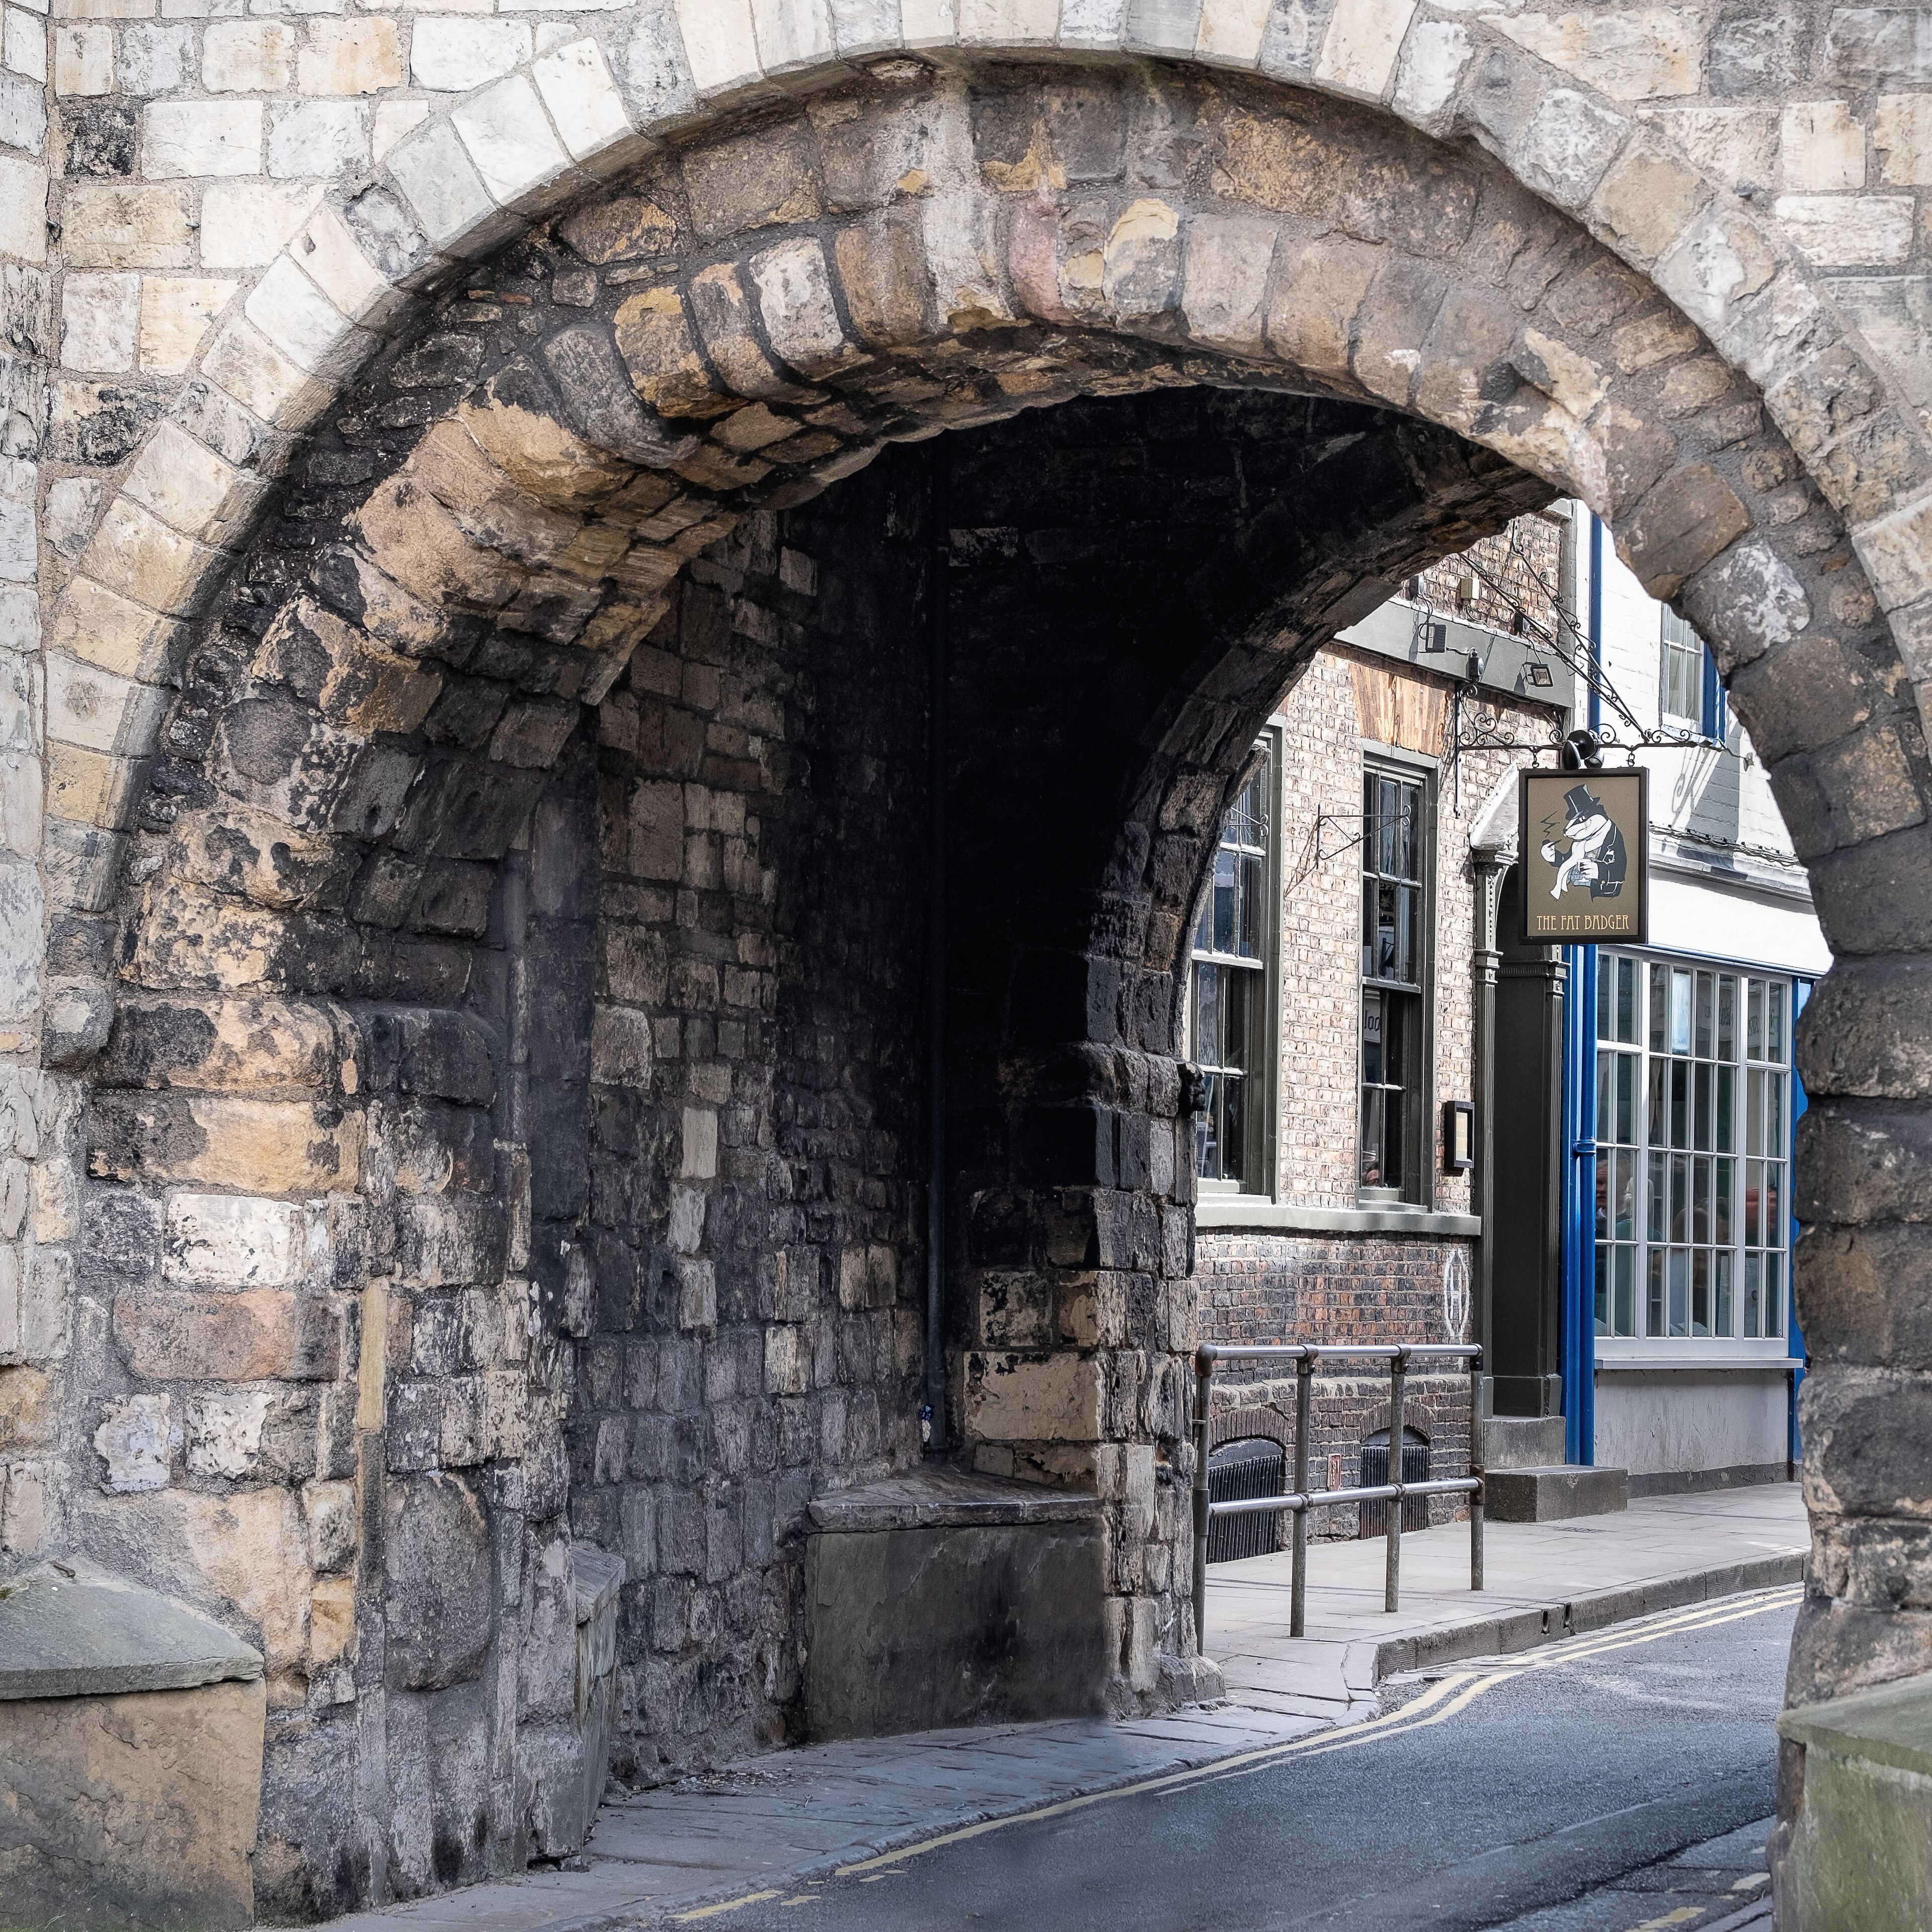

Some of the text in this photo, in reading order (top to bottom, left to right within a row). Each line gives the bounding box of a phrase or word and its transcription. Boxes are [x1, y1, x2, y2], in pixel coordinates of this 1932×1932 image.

[1537, 914, 1629, 930] THE FAT BADGER
